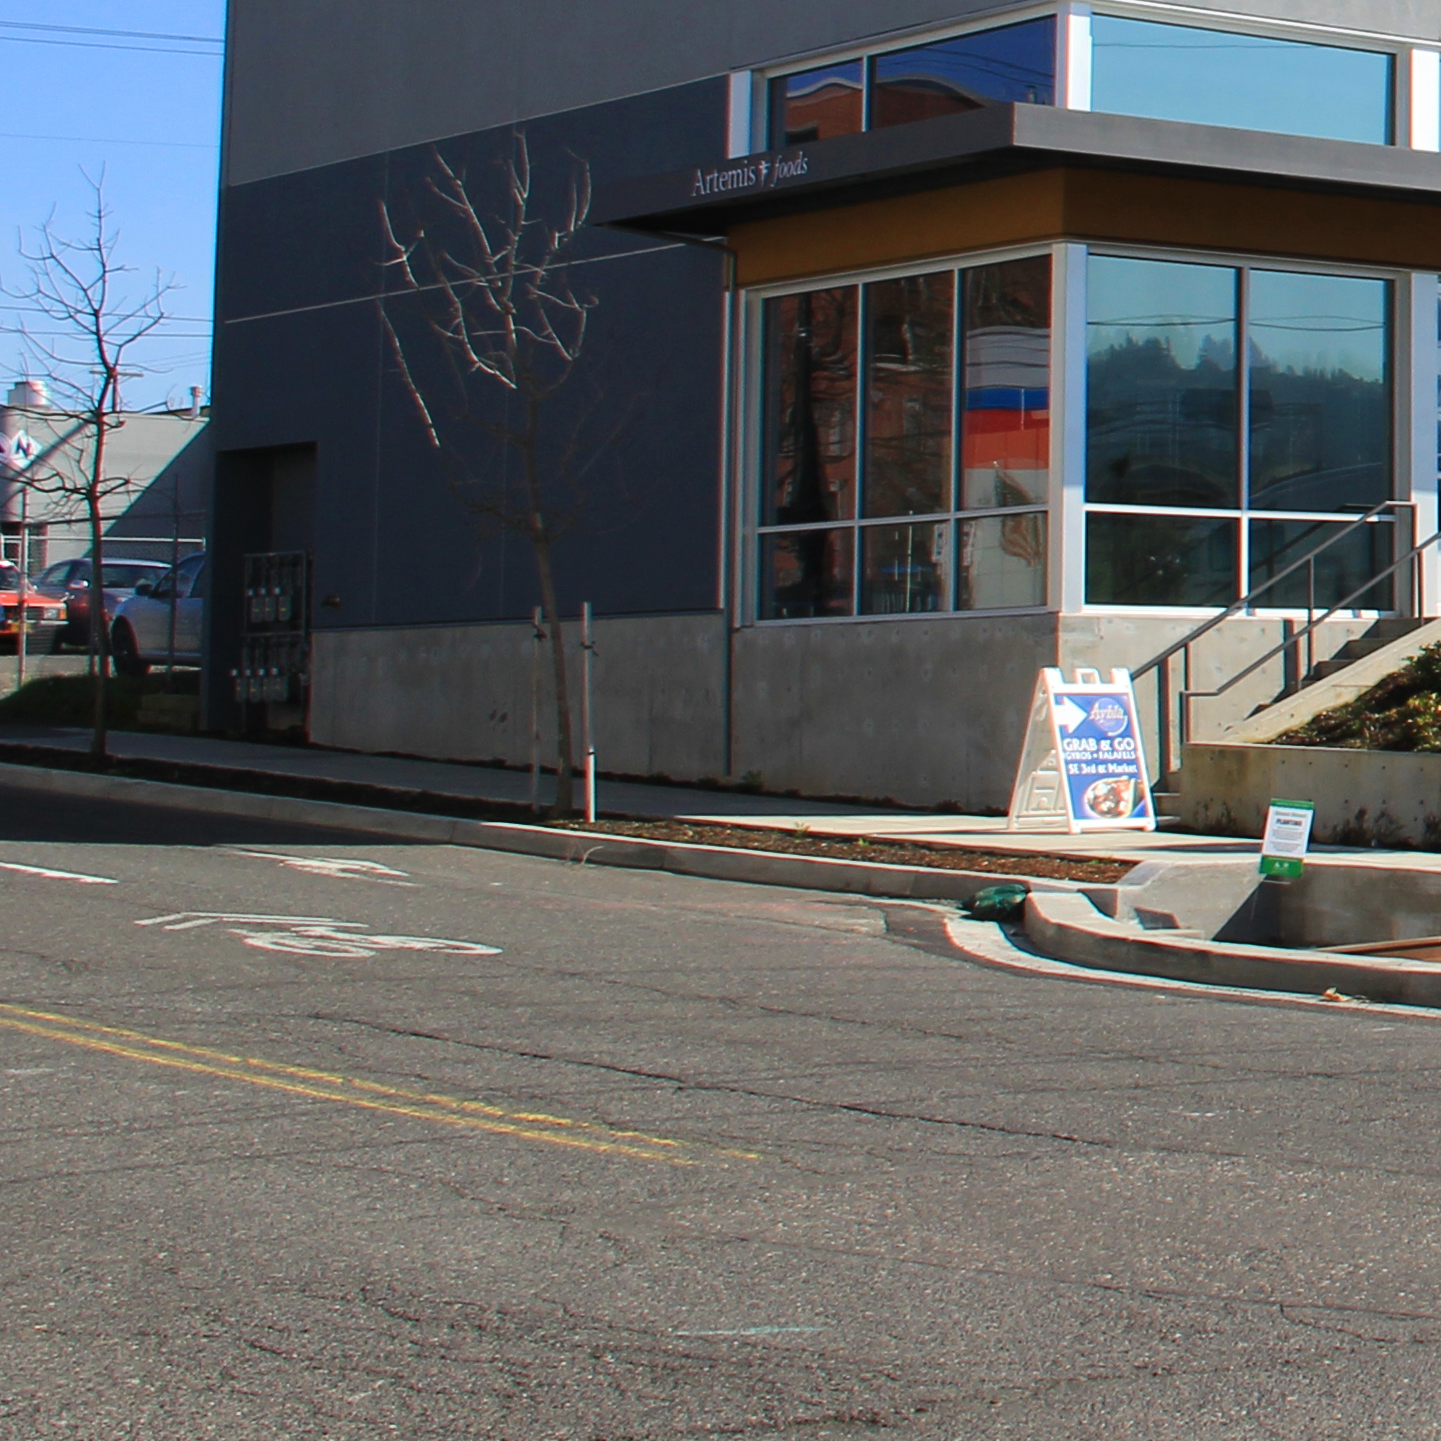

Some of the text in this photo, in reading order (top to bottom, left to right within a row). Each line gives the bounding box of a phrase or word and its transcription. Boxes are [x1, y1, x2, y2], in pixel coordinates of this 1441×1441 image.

[691, 151, 809, 196] Artemis foods
[1063, 737, 1135, 752] GRAB & GO
[1108, 762, 1138, 774] Market
